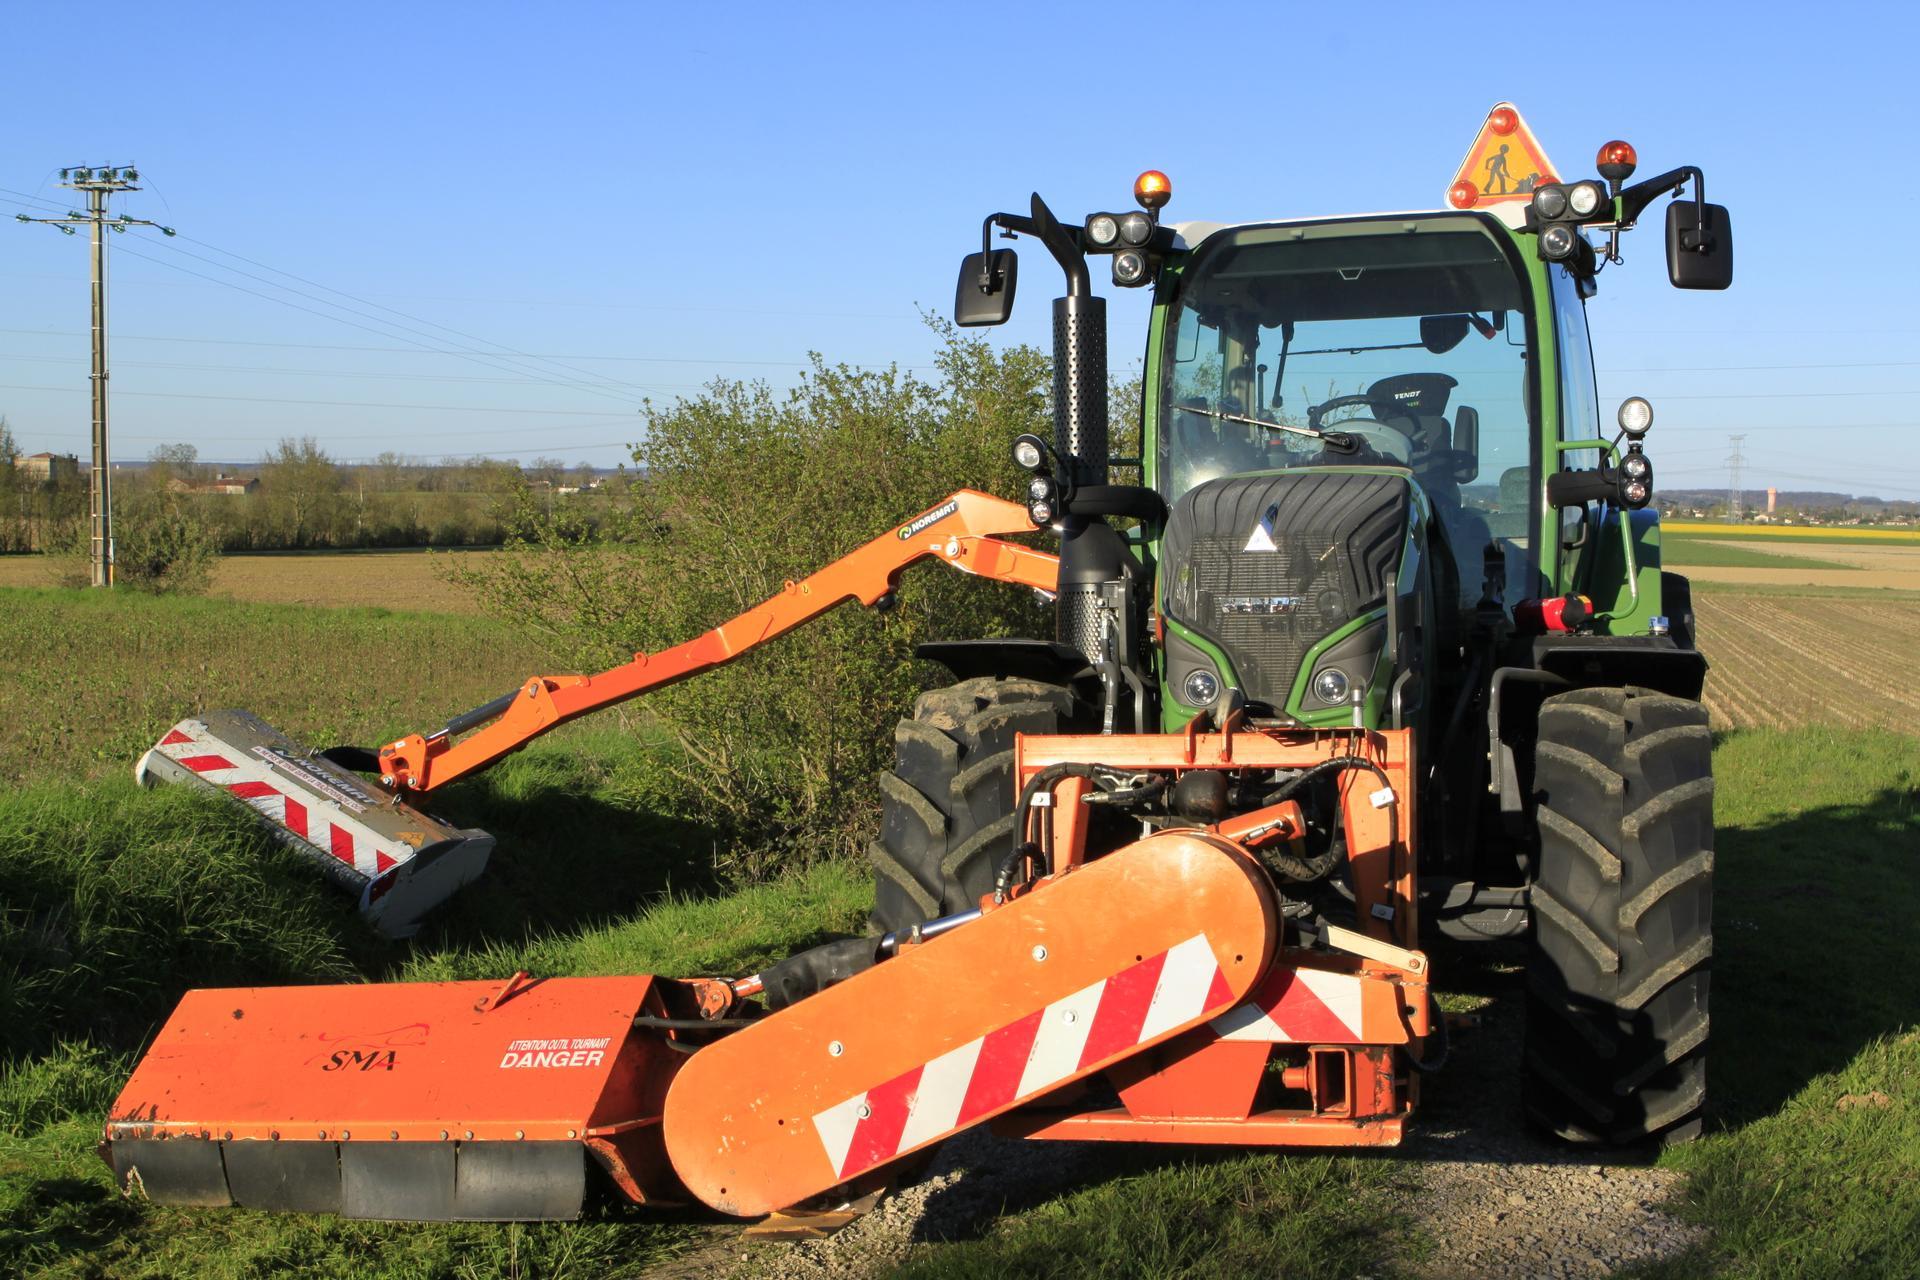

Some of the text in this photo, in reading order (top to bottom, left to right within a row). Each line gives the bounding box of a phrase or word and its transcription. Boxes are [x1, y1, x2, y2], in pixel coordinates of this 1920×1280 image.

[1394, 390, 1421, 400] FENDT
[911, 502, 955, 532] NOREMAT
[294, 758, 379, 804] NOREMAT
[508, 1038, 611, 1050] ATTENTION OUTIL TOURNANT
[322, 1050, 398, 1071] SMA
[500, 1050, 605, 1068] DANGER
